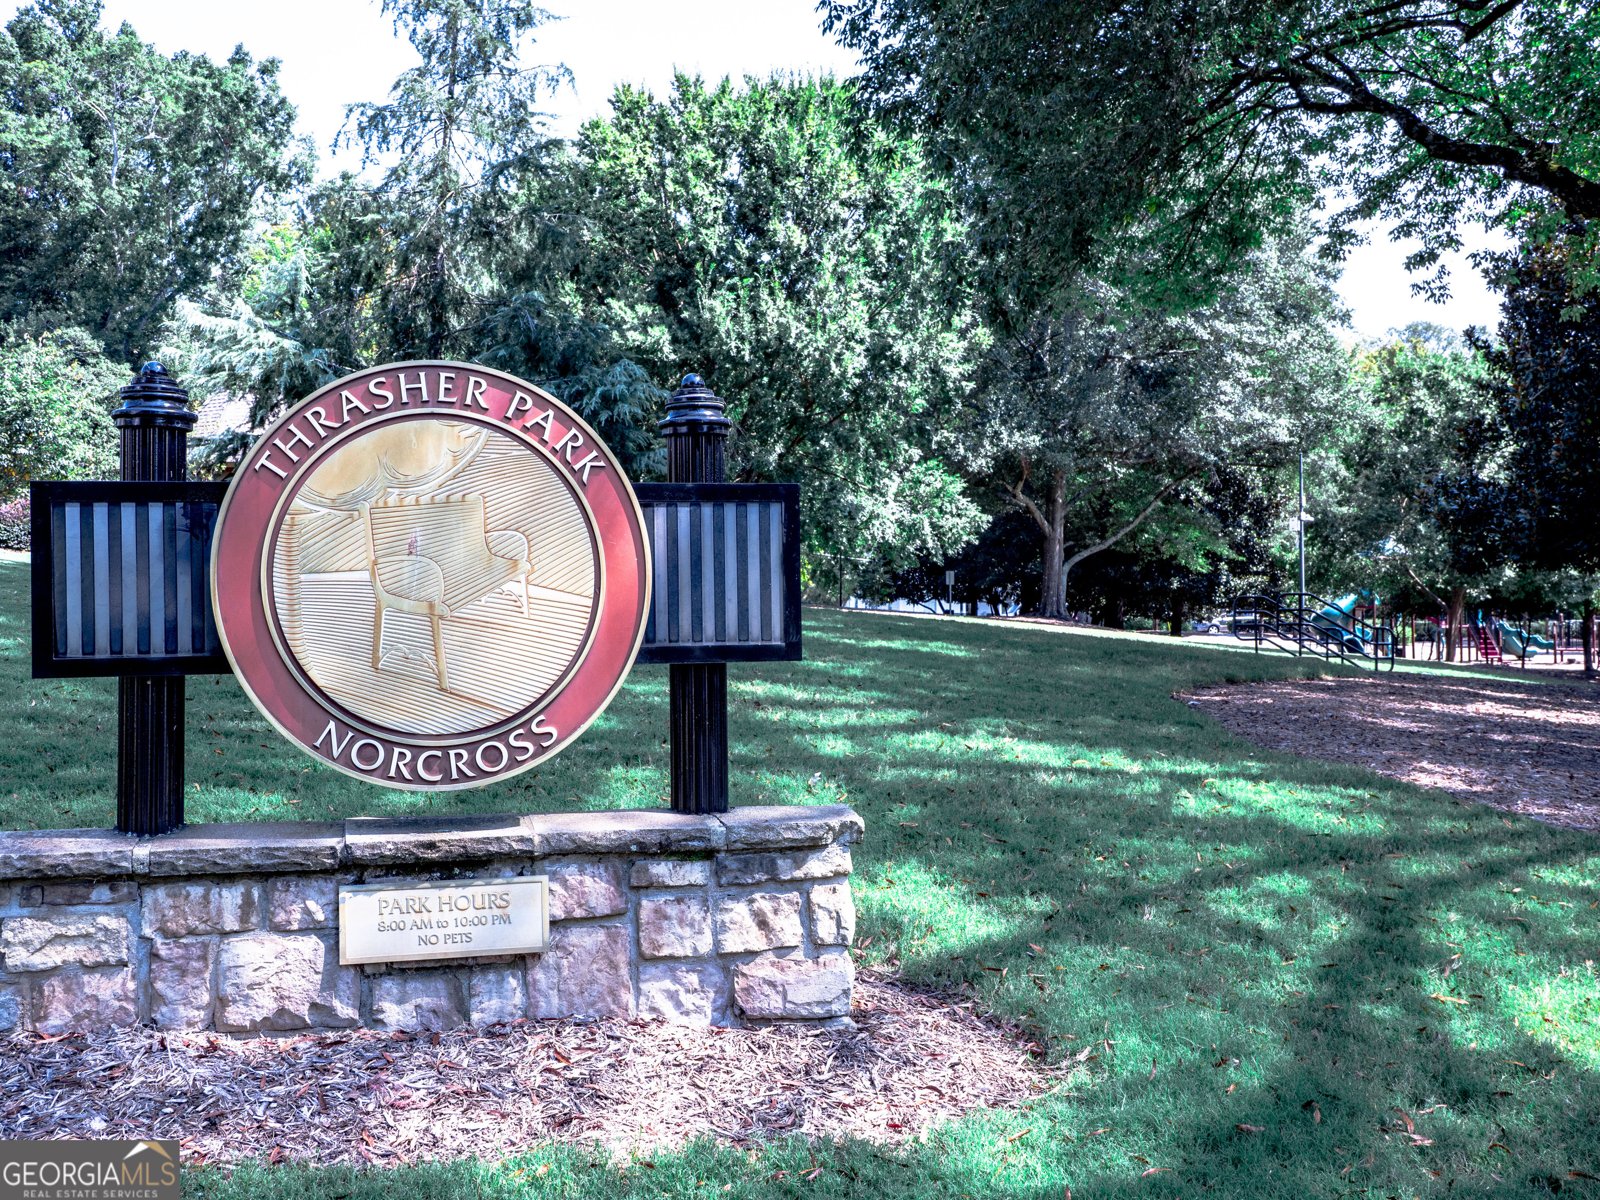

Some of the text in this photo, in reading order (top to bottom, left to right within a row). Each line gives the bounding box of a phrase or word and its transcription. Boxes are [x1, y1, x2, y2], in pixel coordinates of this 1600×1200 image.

[254, 371, 606, 486] THRASHER PARK
[313, 714, 558, 782] NORCROSS
[378, 892, 511, 916] PARK HOURS
[377, 913, 512, 932] 8:00 AM to 10:00 PM
[418, 932, 473, 946] NO PETS
